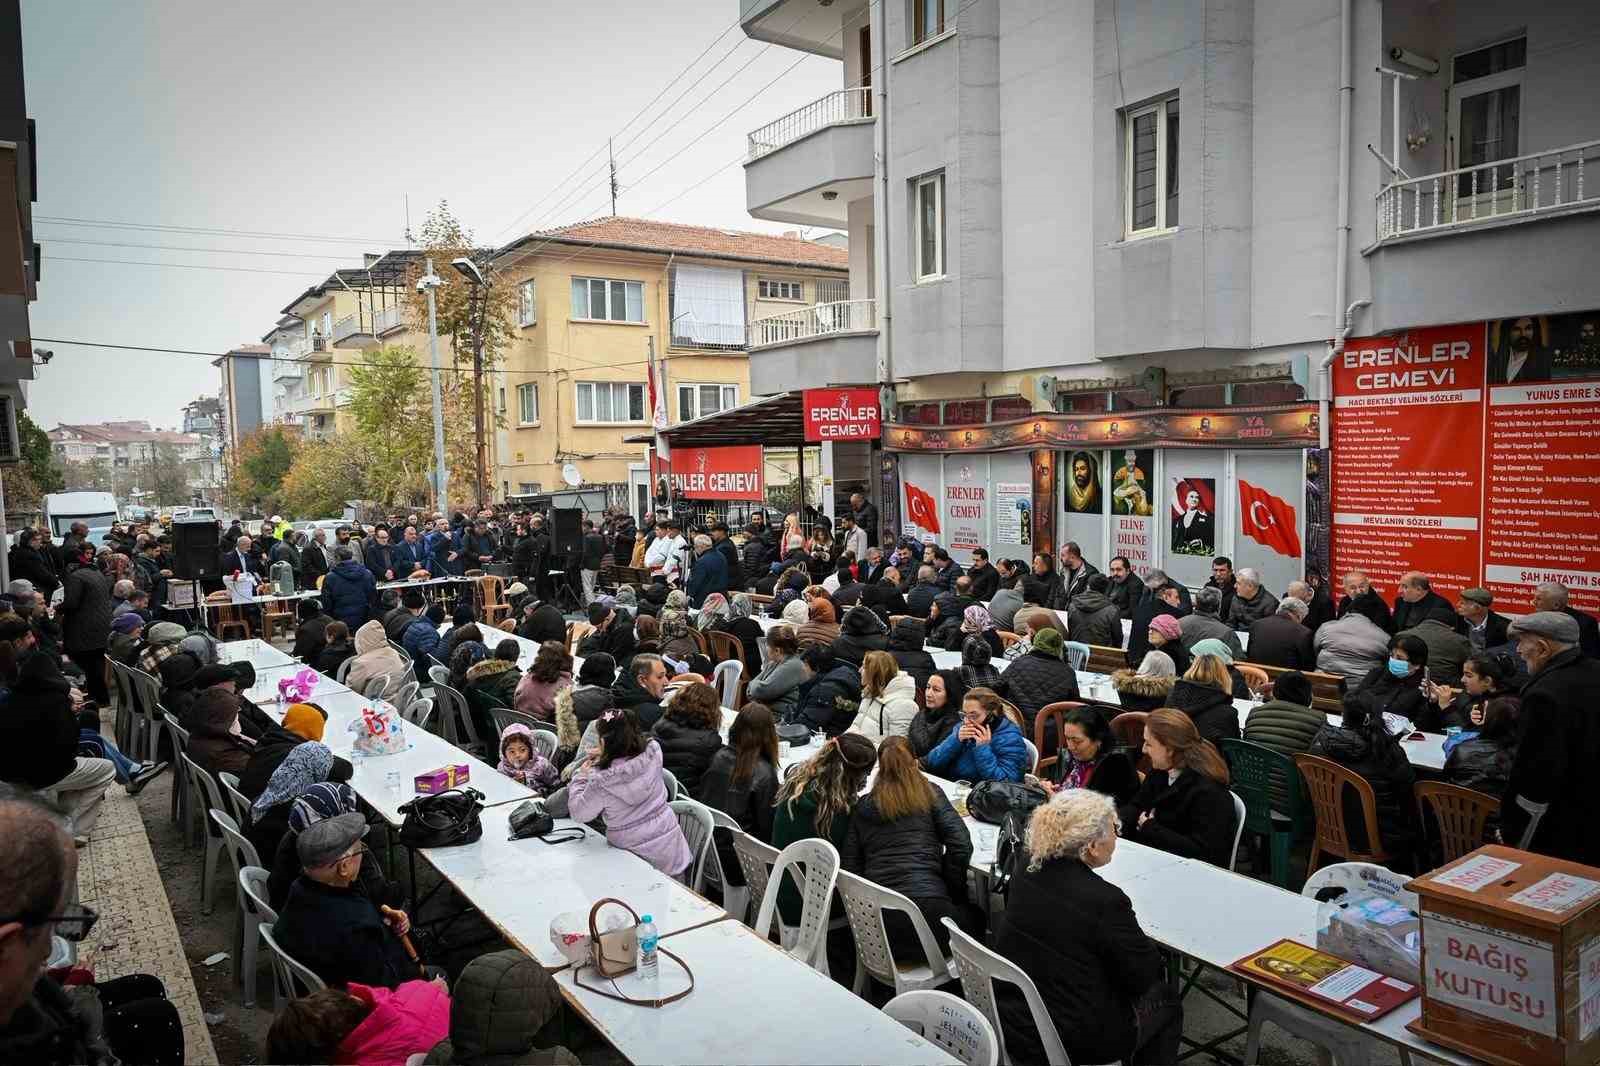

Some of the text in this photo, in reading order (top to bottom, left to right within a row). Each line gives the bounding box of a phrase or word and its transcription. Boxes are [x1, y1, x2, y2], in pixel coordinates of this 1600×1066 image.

[1343, 341, 1471, 369] ERENLER
[1526, 390, 1560, 401] YUNUS
[1563, 388, 1591, 399] EMRE
[811, 407, 877, 421] ERENLER
[655, 468, 758, 492] ENLER CEMEVİ
[946, 486, 985, 501] ERENLER
[950, 503, 982, 519] CEMEVİ
[1447, 936, 1529, 982] BAĞIŞ
[1433, 967, 1546, 1020] KUTUSU
